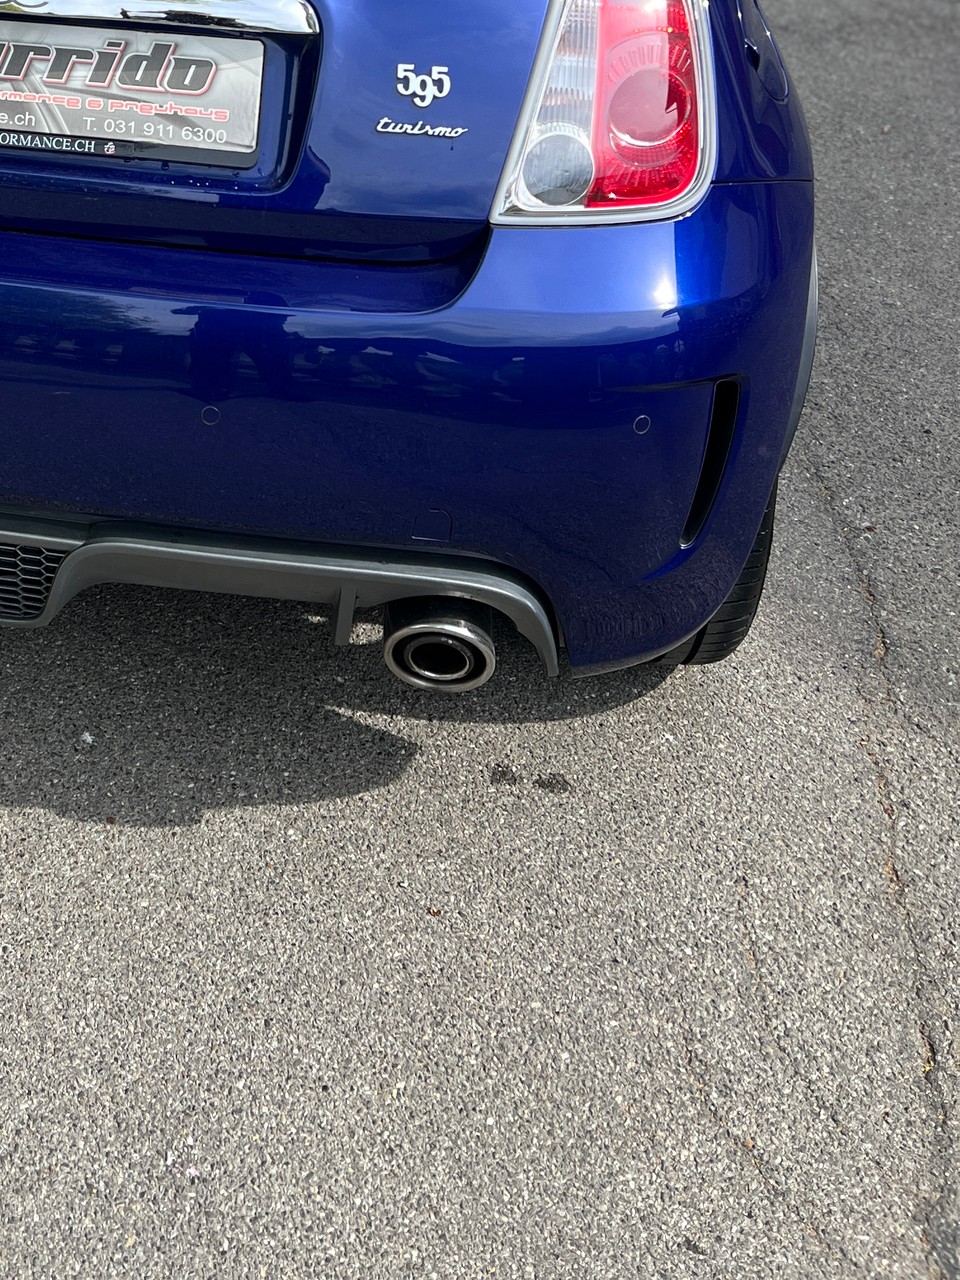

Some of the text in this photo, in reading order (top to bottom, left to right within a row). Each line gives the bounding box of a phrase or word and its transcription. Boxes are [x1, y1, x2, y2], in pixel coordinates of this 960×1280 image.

[396, 63, 451, 108] 595
[83, 116, 227, 144] T. 031 911 6300
[376, 117, 468, 137] turismo
